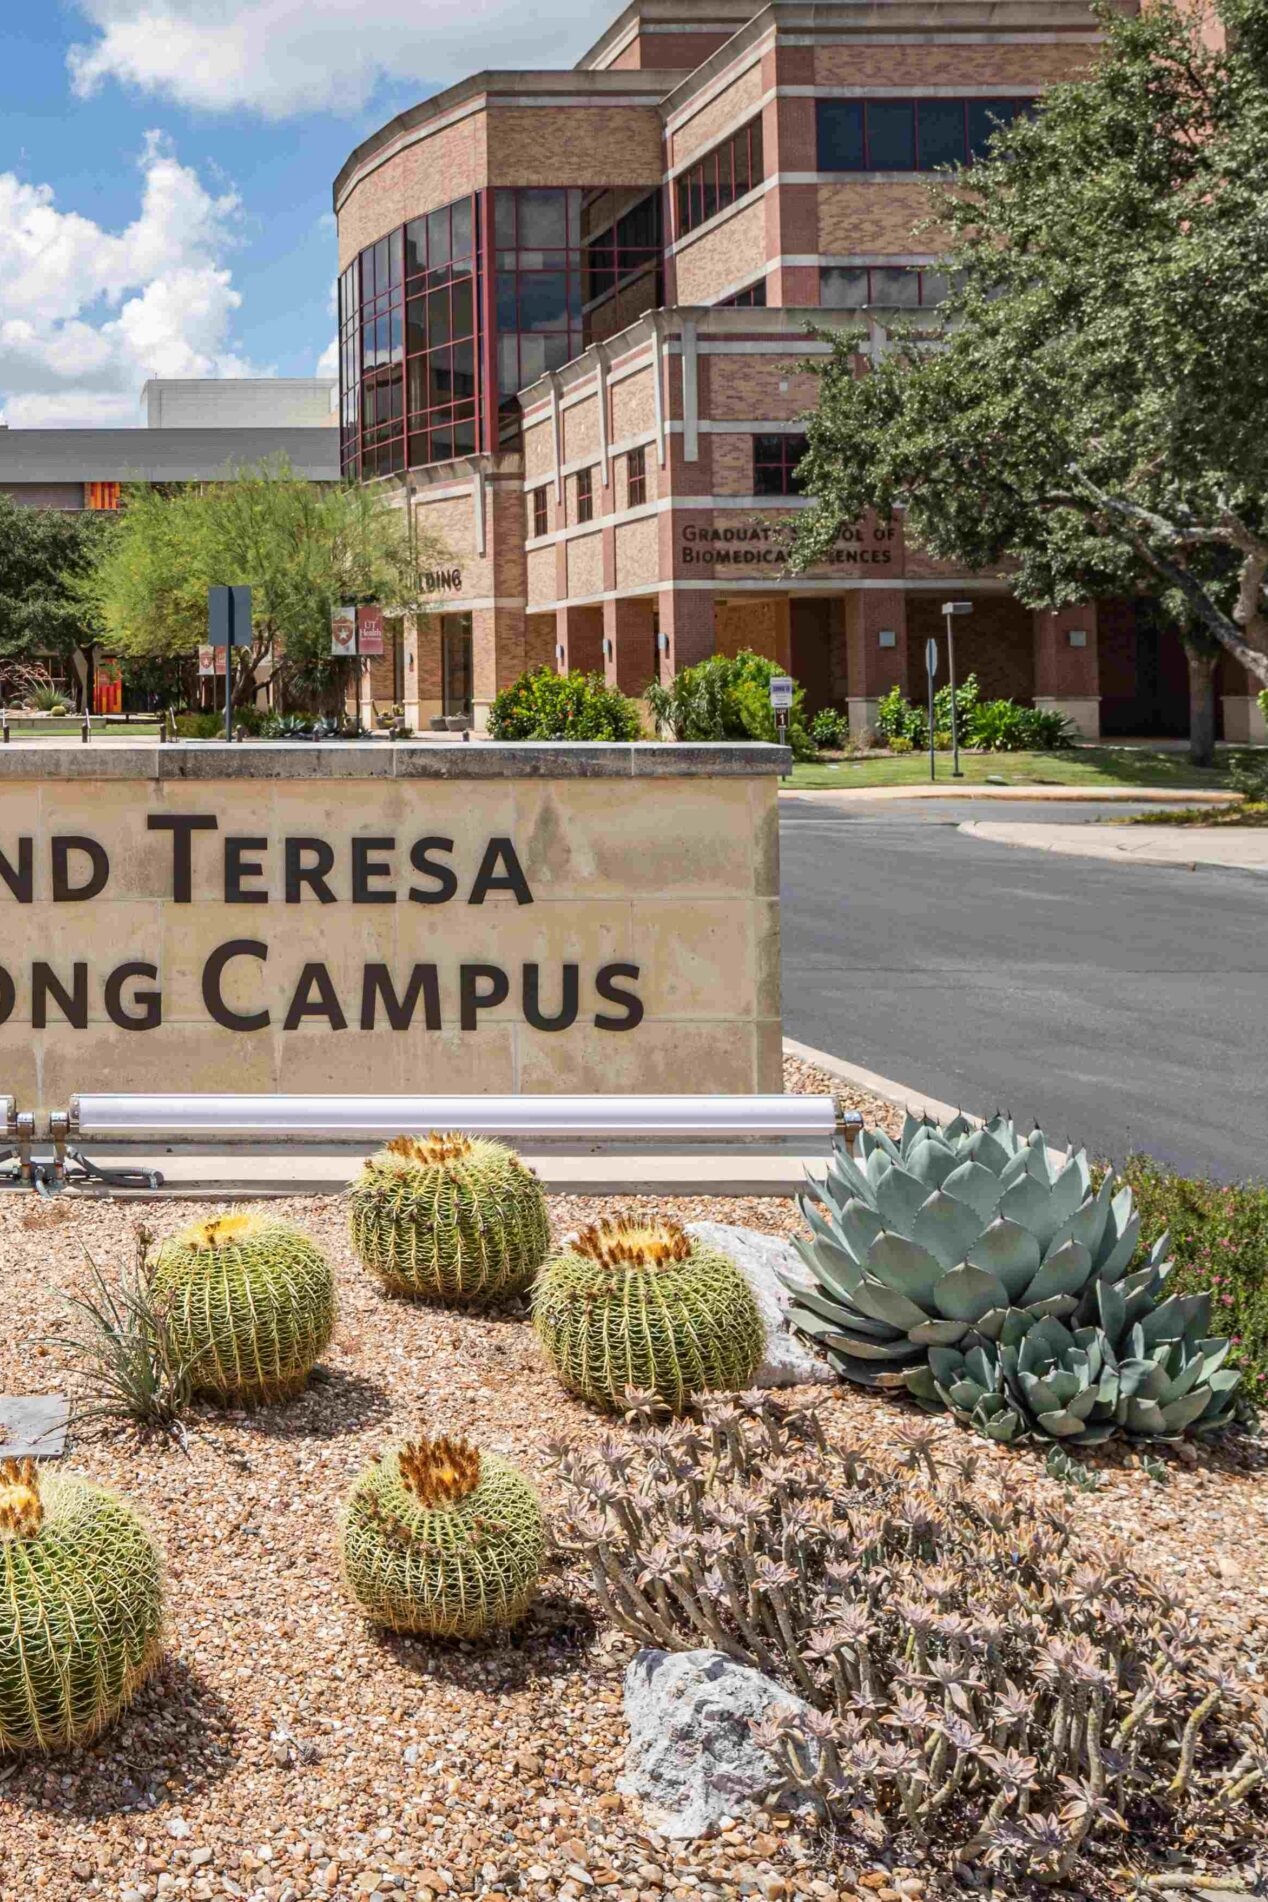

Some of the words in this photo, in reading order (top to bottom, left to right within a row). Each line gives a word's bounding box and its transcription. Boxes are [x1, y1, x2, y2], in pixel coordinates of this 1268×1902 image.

[682, 524, 781, 542] GRADUAT
[873, 528, 895, 541] OF
[146, 813, 535, 906] TERESA
[201, 938, 645, 1032] CAMPUS
